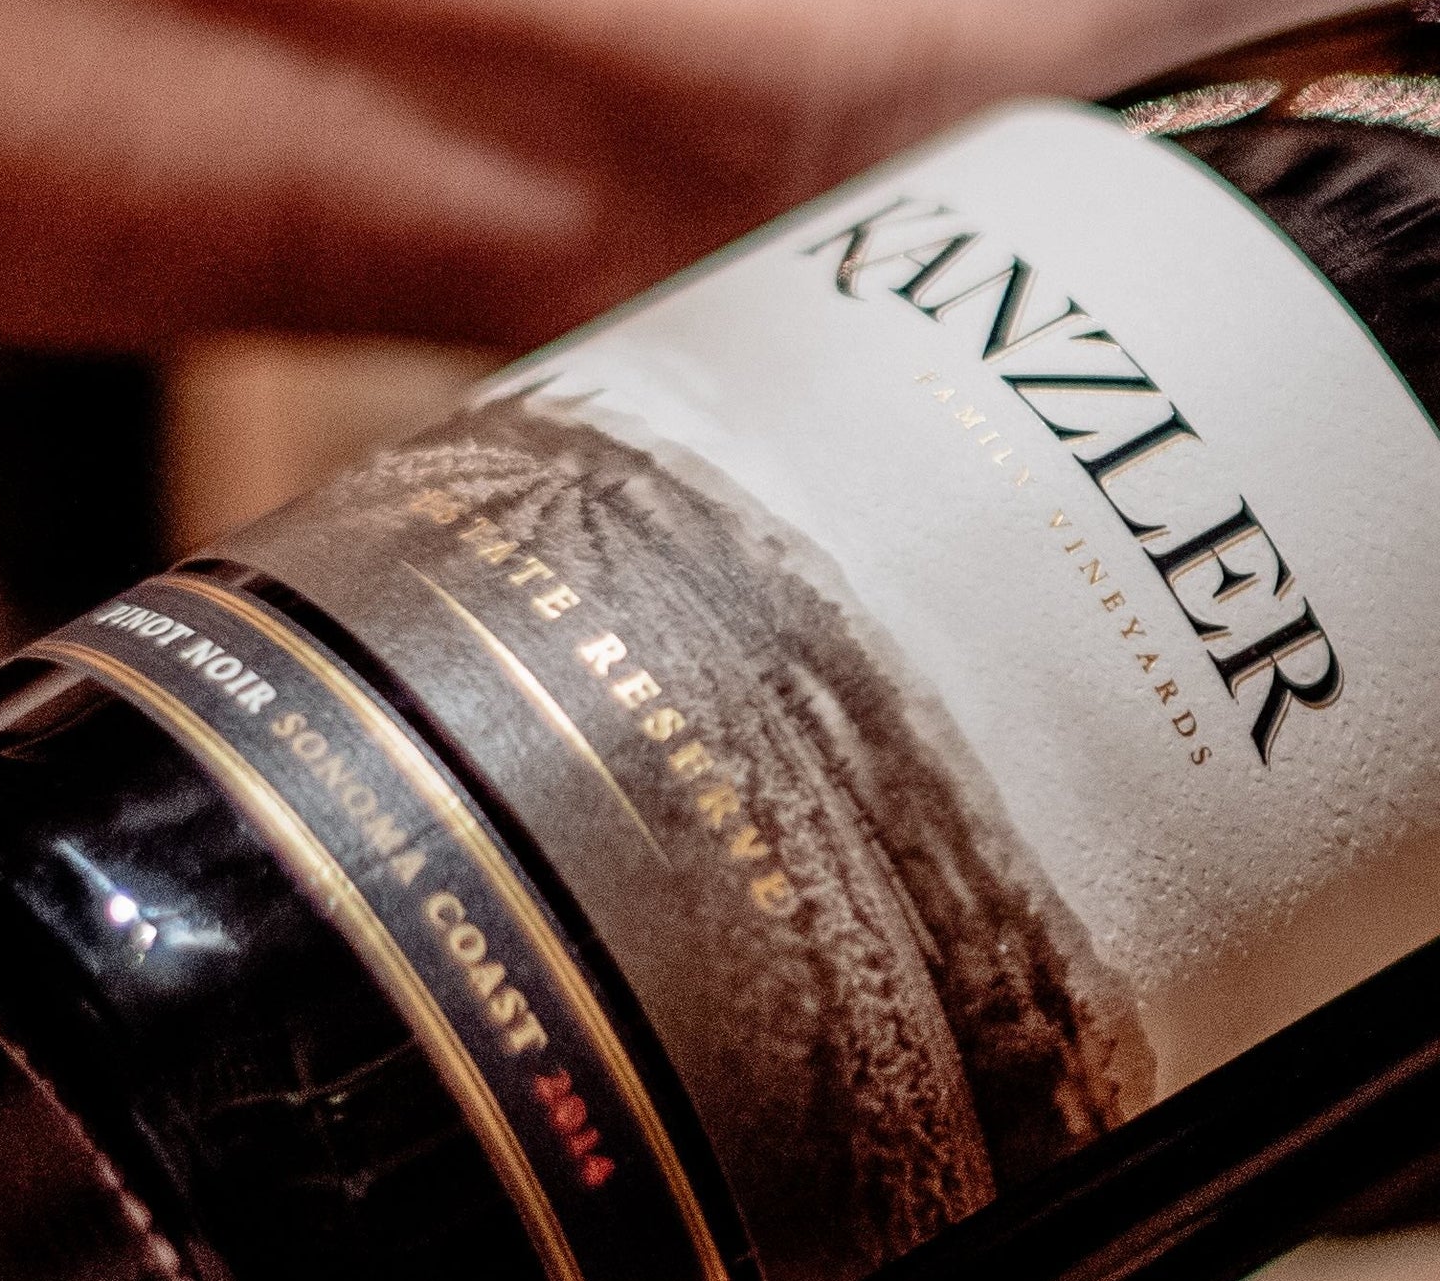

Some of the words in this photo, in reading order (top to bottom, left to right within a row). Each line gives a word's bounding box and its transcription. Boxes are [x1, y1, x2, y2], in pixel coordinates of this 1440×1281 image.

[801, 195, 1346, 767] KANZLER
[1048, 508, 1213, 767] VINEYARDS
[96, 604, 197, 647] PINOT
[178, 638, 278, 715] NOIR
[270, 712, 427, 886] SONOMA
[422, 890, 550, 1054] COAST
[532, 1068, 616, 1188] 2014
[577, 631, 794, 914] RESERVE
